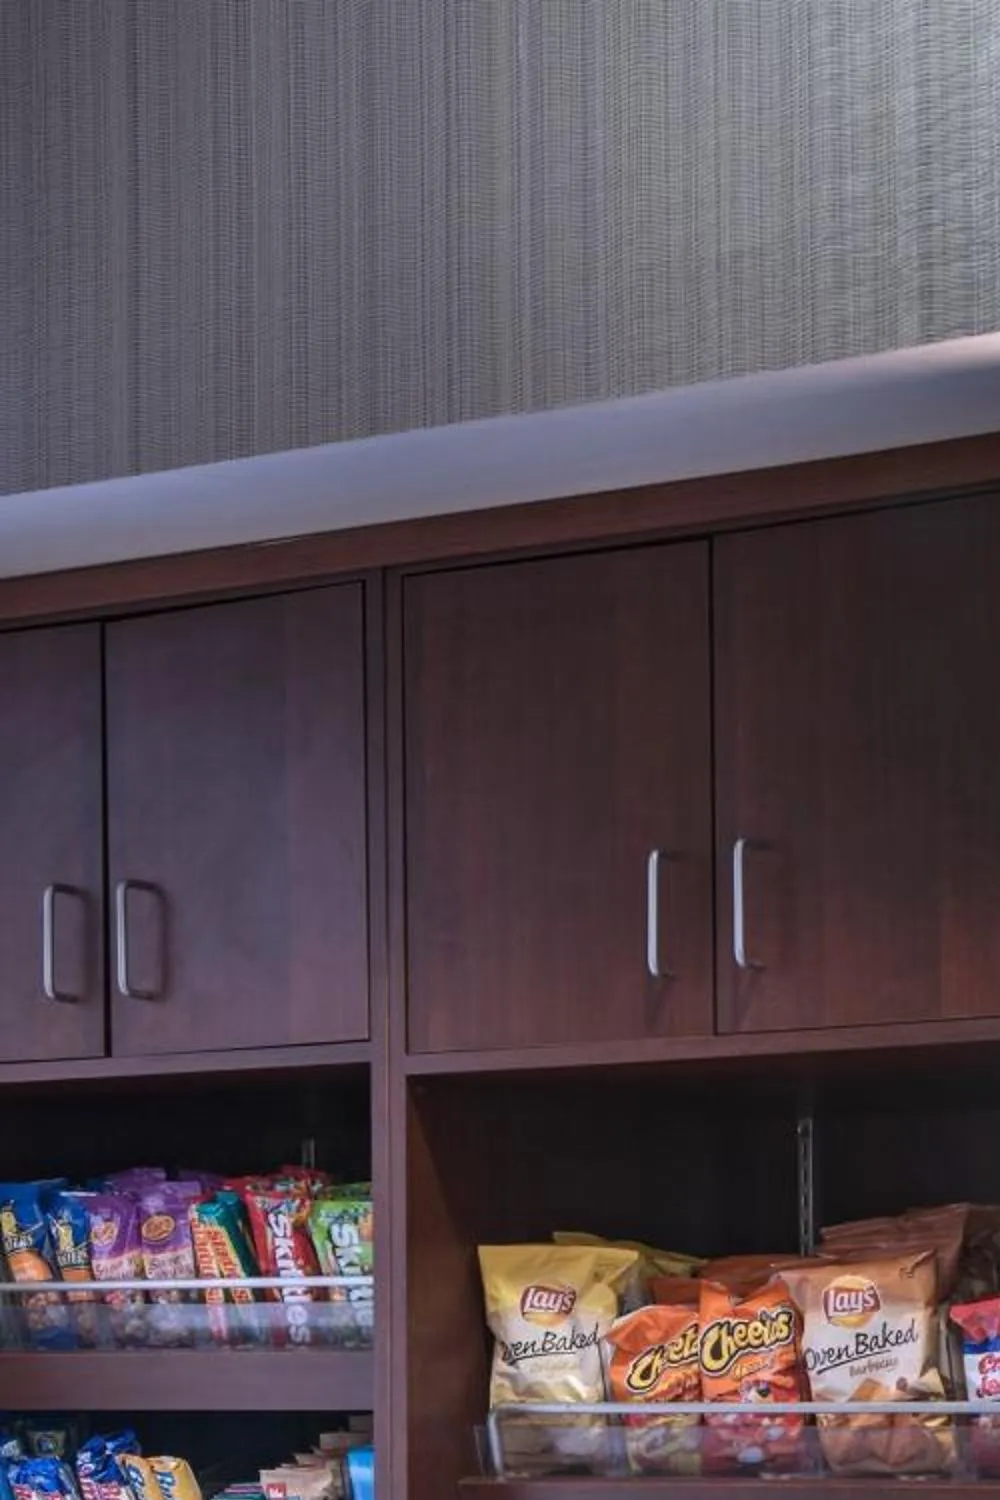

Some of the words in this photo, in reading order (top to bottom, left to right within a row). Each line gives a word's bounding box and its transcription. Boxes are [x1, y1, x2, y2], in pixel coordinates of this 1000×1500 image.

[523, 1287, 577, 1313] Lay's
[825, 1285, 880, 1313] Lay's
[541, 1321, 600, 1352] Baked
[803, 1345, 852, 1371] Oven
[854, 1319, 919, 1356] Baked
